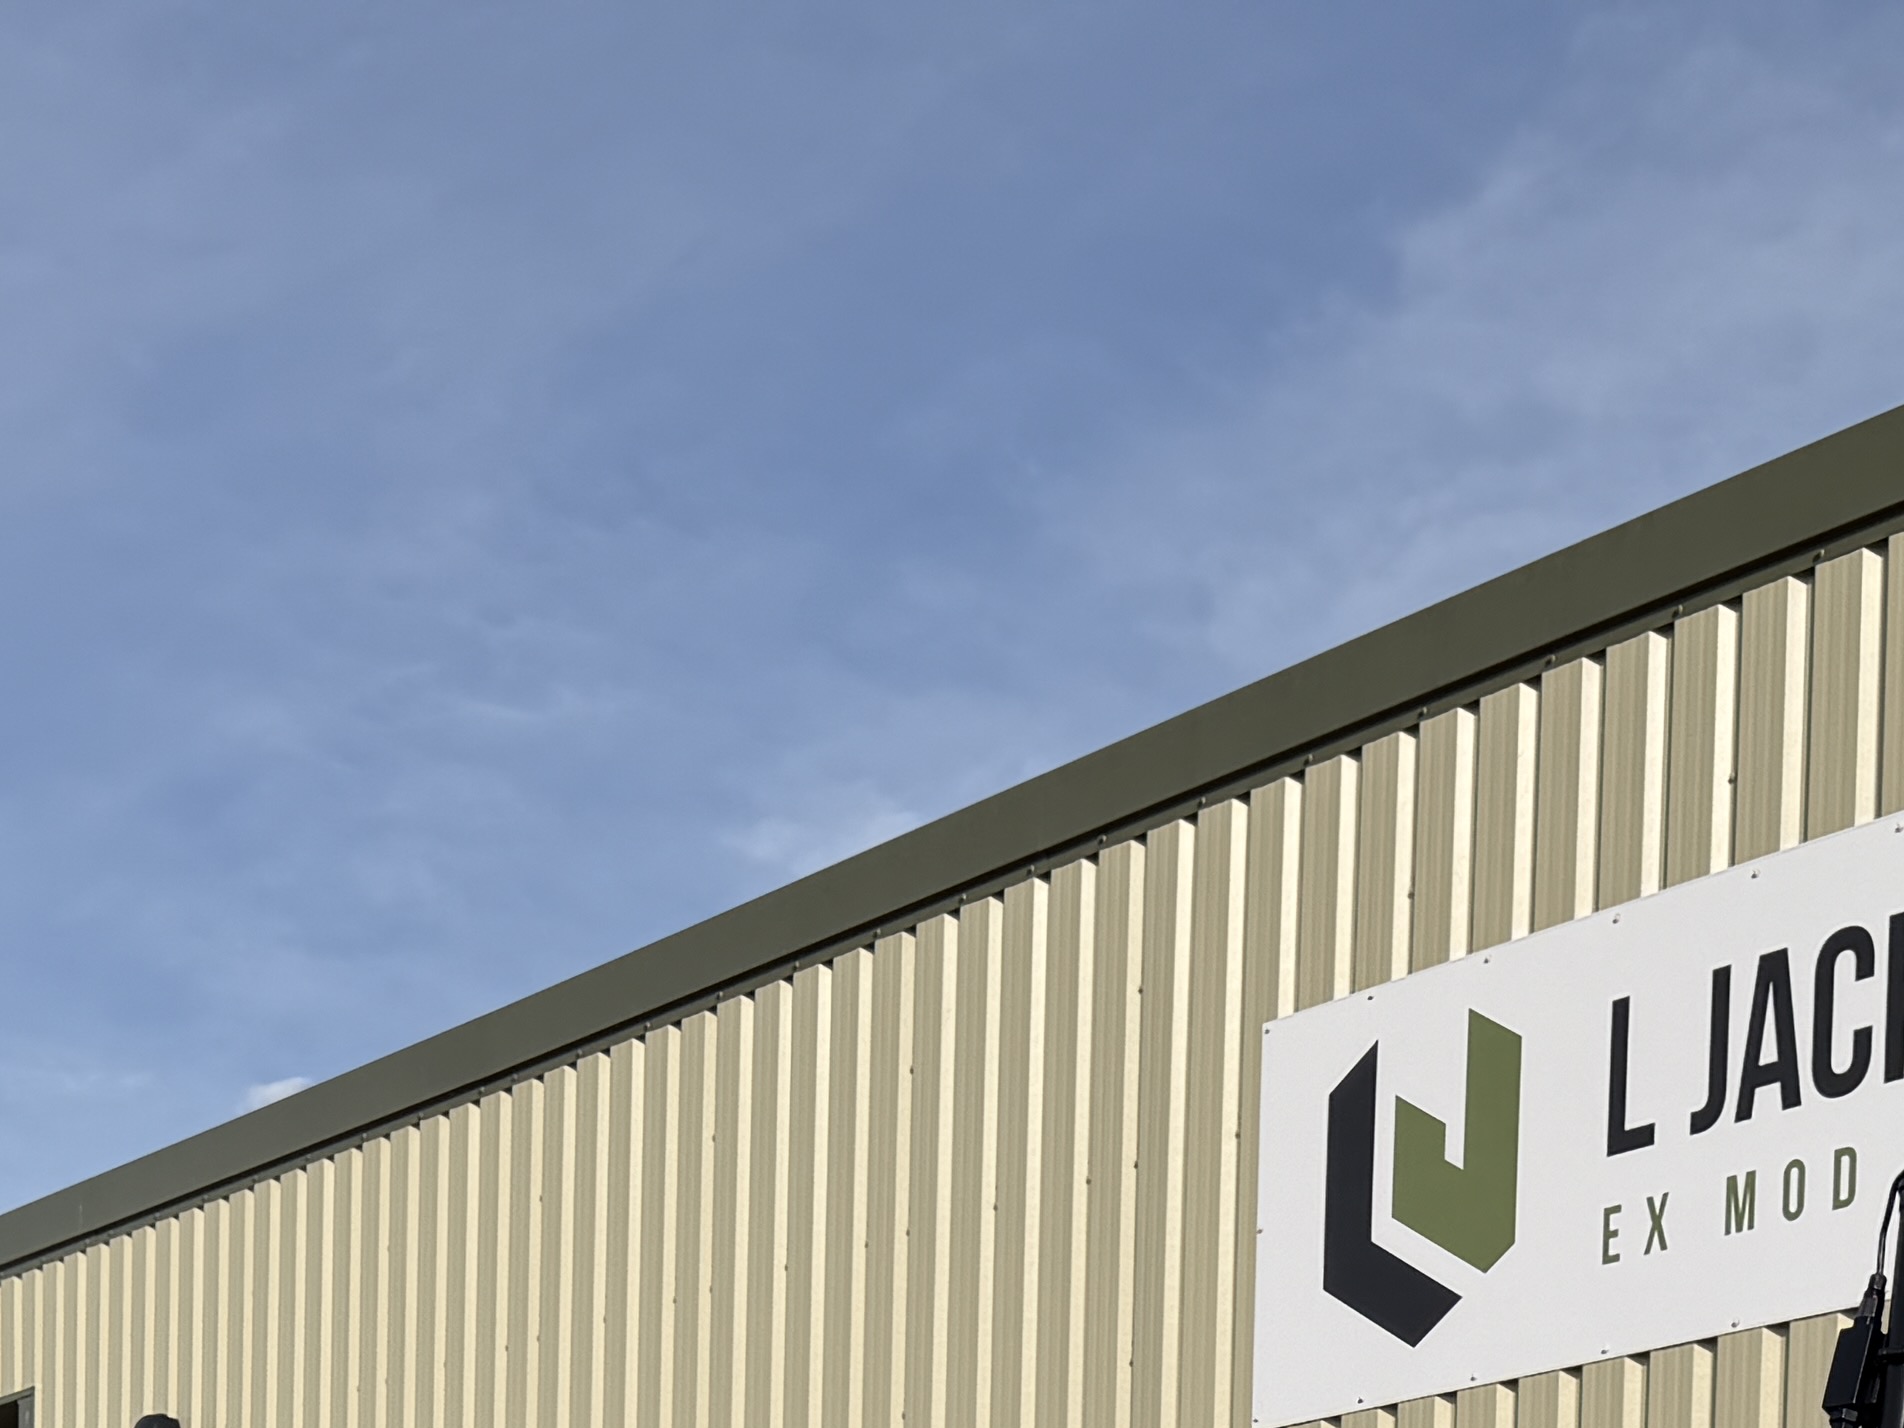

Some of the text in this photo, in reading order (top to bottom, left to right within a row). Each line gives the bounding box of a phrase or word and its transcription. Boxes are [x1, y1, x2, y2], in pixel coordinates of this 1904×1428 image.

[1606, 995, 1656, 1158] L
[1601, 1191, 1670, 1266] EX
[1724, 1146, 1858, 1236] MOD
